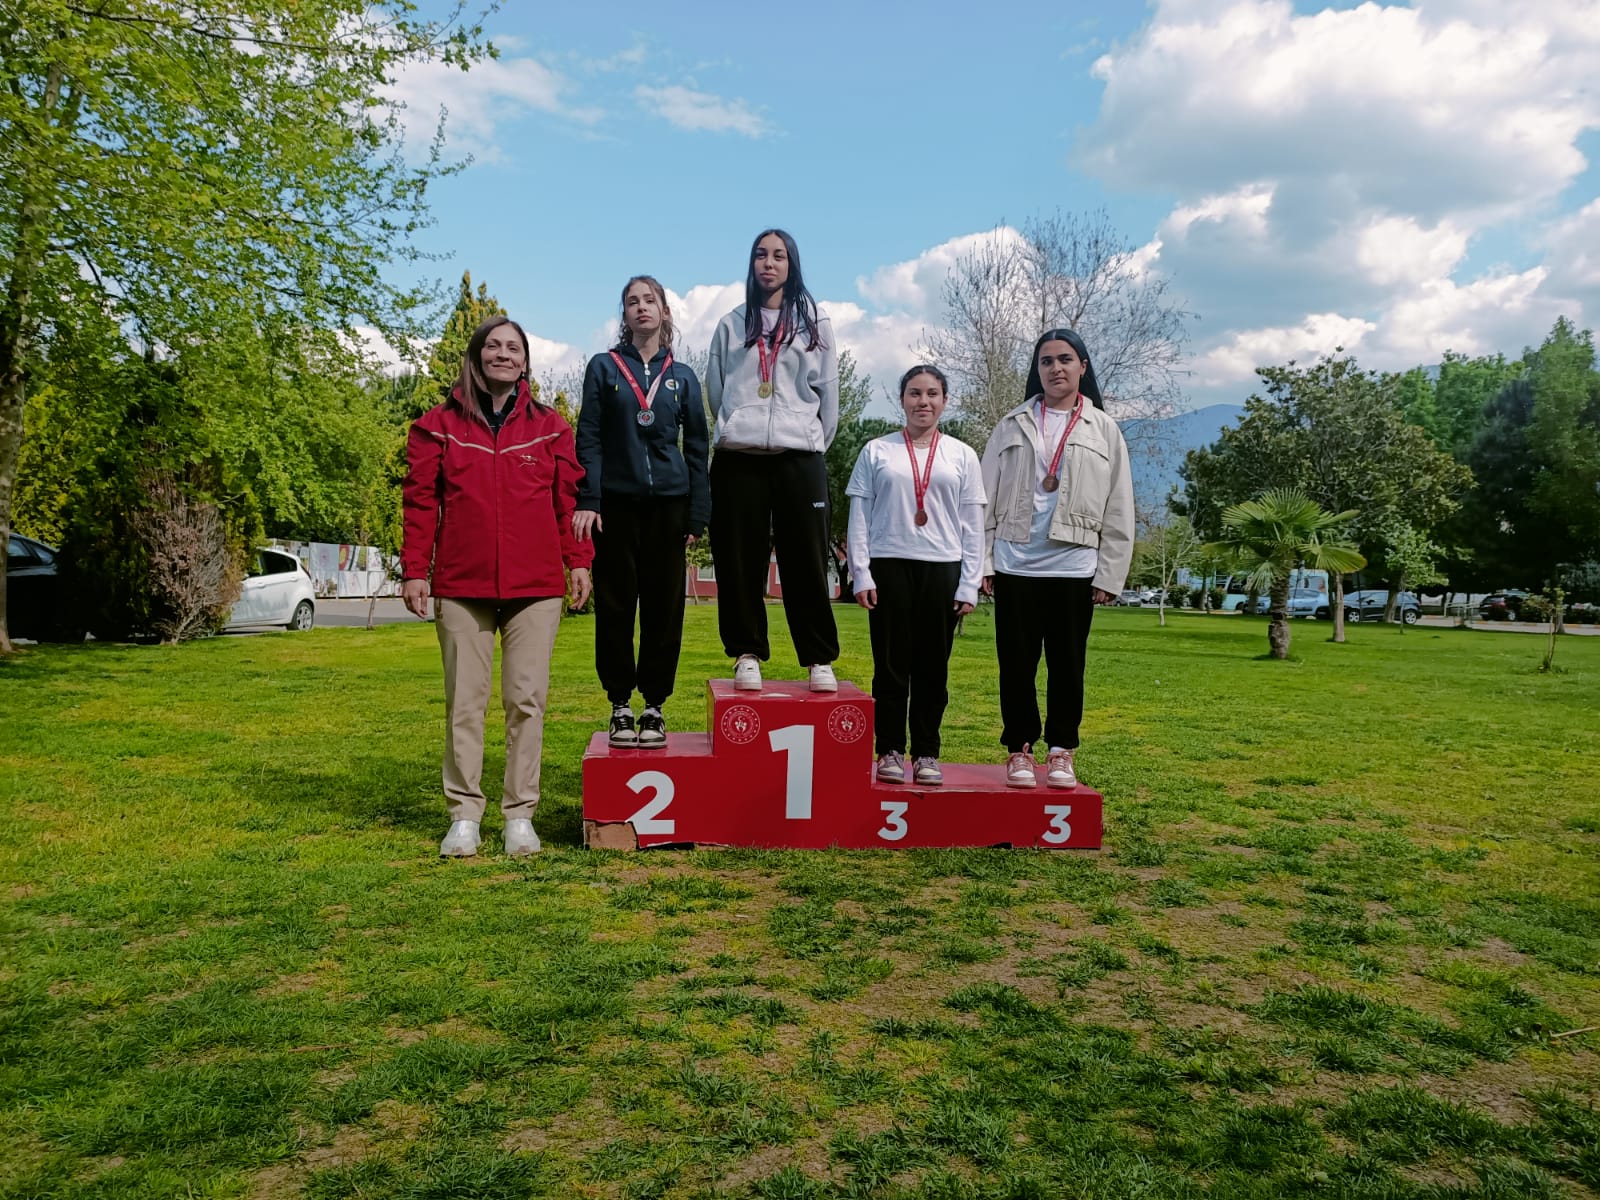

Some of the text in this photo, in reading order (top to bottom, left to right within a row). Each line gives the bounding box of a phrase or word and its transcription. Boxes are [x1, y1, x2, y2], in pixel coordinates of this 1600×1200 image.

[768, 725, 814, 820] 1
[625, 771, 675, 835] 2
[878, 802, 909, 840] 3
[1042, 805, 1072, 844] 3
